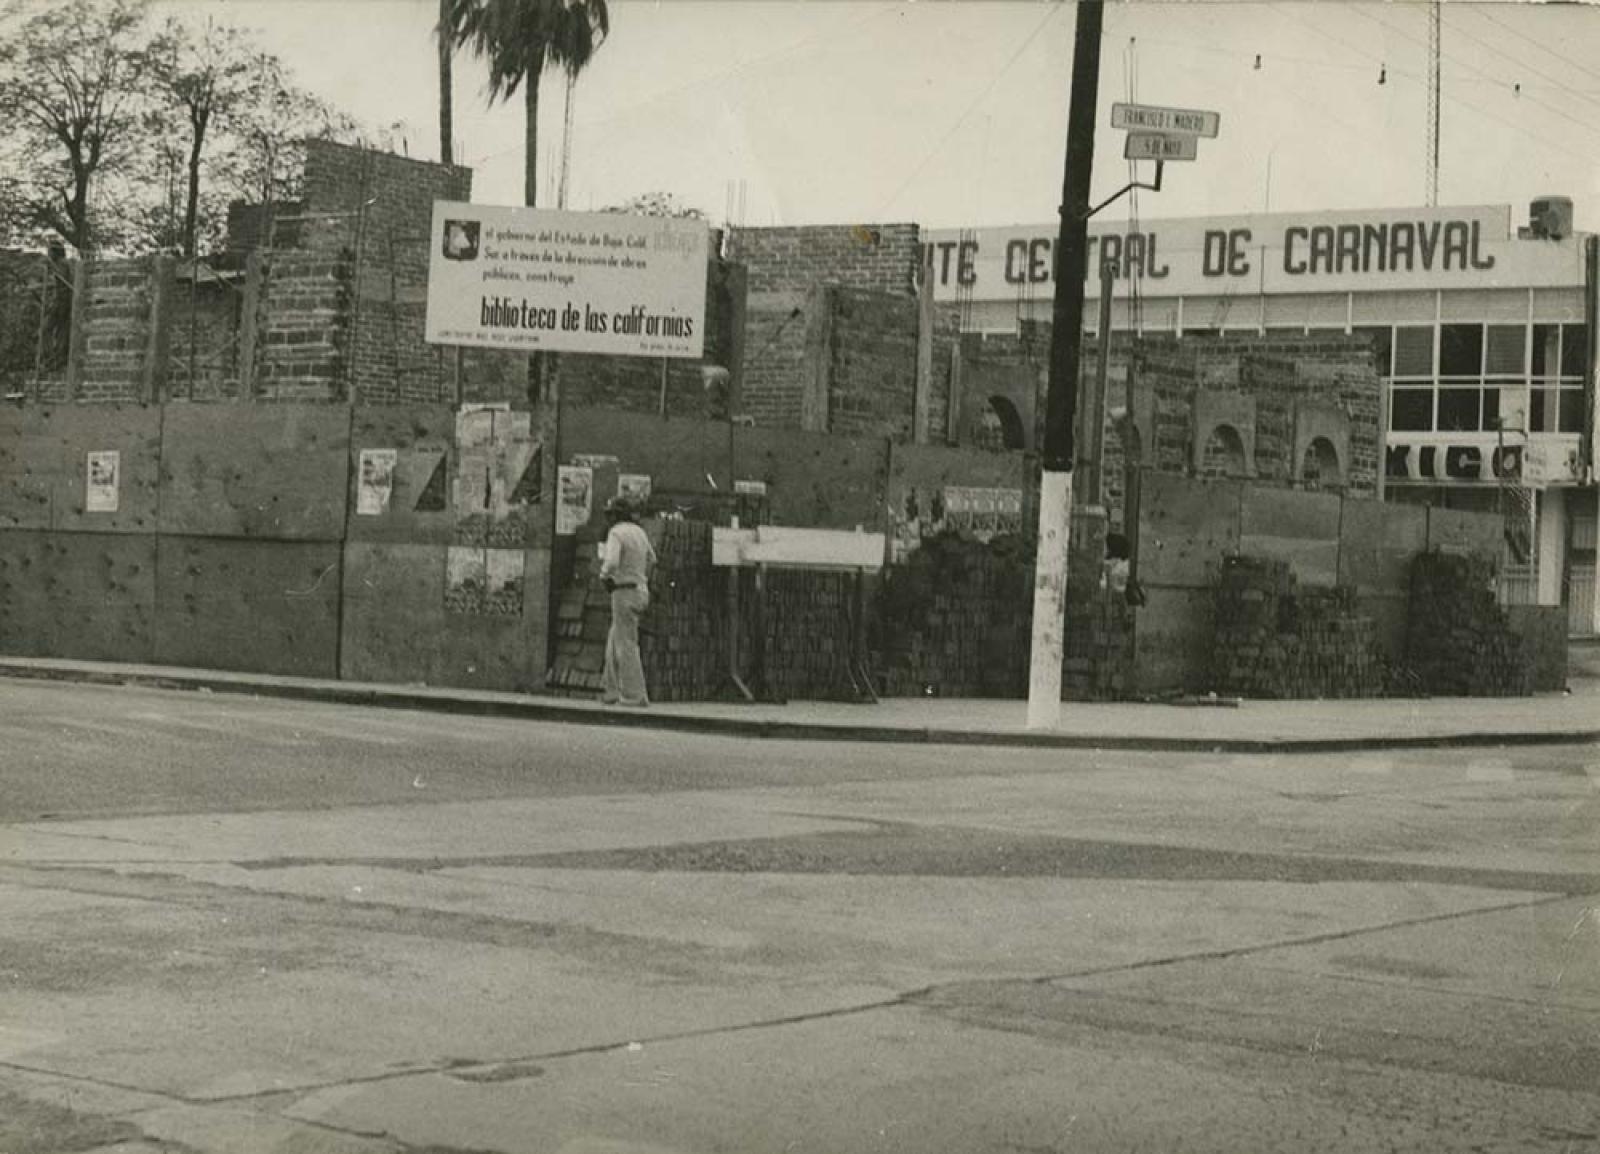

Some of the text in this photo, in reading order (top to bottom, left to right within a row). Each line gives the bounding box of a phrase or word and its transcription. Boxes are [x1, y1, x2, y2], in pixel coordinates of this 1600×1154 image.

[917, 241, 979, 286] ITE
[1202, 228, 1252, 278] DE
[1283, 219, 1496, 276] CARNAVAL
[480, 295, 694, 337] biblioteca de las californias
